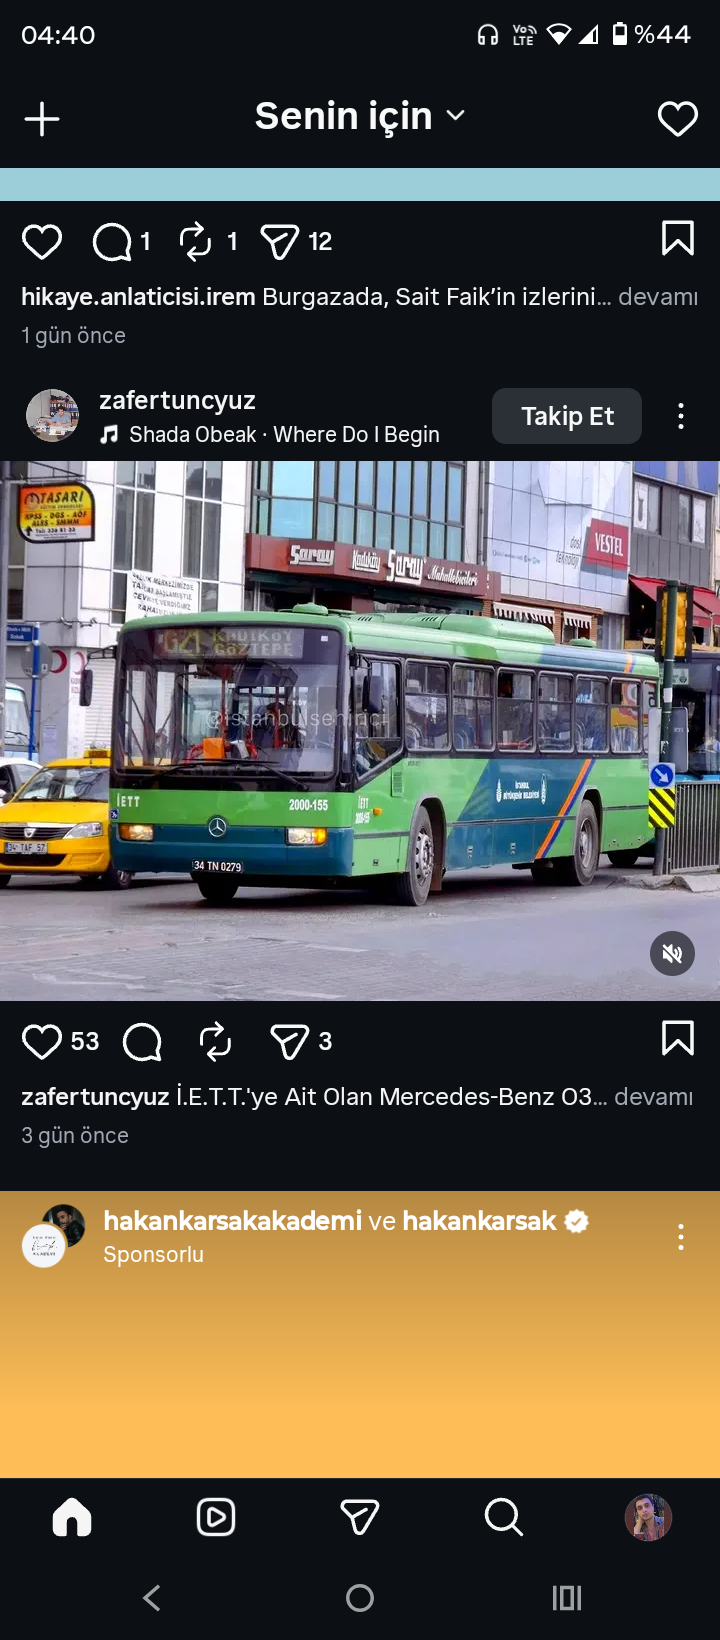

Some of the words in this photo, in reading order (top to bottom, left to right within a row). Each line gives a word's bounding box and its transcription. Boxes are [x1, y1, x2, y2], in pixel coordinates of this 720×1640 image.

[22, 26, 95, 44] 04:40
[513, 36, 533, 45] LTE
[635, 25, 691, 43] %44
[255, 100, 357, 129] Senin
[370, 100, 431, 138] için
[141, 232, 149, 250] 1
[228, 232, 236, 250] 1
[309, 232, 332, 250] 12
[22, 287, 255, 310] hikaye.anlaticisi.irem
[264, 287, 388, 310] Burgazada,
[396, 287, 439, 305] Sait
[619, 287, 697, 305] devamı
[22, 327, 28, 343] 1
[36, 326, 71, 348] gün
[78, 326, 125, 343] önce
[100, 390, 255, 415] zafertuncyuz
[521, 405, 583, 430] Takip
[590, 407, 614, 425] Et
[130, 426, 189, 442] Shada
[196, 426, 256, 442] Obeak
[273, 426, 336, 442] Where
[343, 426, 368, 442] Do
[375, 426, 379, 442] I
[385, 425, 439, 447] Begin
[40, 491, 84, 503] TASARI
[595, 532, 624, 557] VESTEL
[290, 544, 335, 567] Saray
[351, 549, 381, 573] Kadıköy
[386, 549, 423, 585] Saray
[116, 794, 140, 808] İETT
[289, 798, 329, 812] 2000-155
[8, 843, 17, 852] 34
[37, 843, 46, 852] 57
[194, 860, 204, 870] 34
[207, 861, 219, 871] TN
[220, 862, 242, 872] 0279
[71, 1032, 99, 1050] 53
[319, 1032, 332, 1050] 3
[22, 1087, 169, 1110] zafertuncyuz
[178, 1083, 277, 1110] İ.E.T.T.'ye
[284, 1087, 316, 1105] Ait
[324, 1087, 372, 1105] Olan
[381, 1087, 554, 1105] Mercedes-Benz
[615, 1087, 692, 1105] devamı
[22, 1127, 32, 1143] 3
[39, 1126, 74, 1148] gün
[81, 1126, 128, 1143] önce
[105, 1209, 361, 1230] hakankarsakakademi
[369, 1216, 395, 1230] ve
[404, 1210, 557, 1230] hakankarsak
[104, 1246, 203, 1267] Sponsorlu
